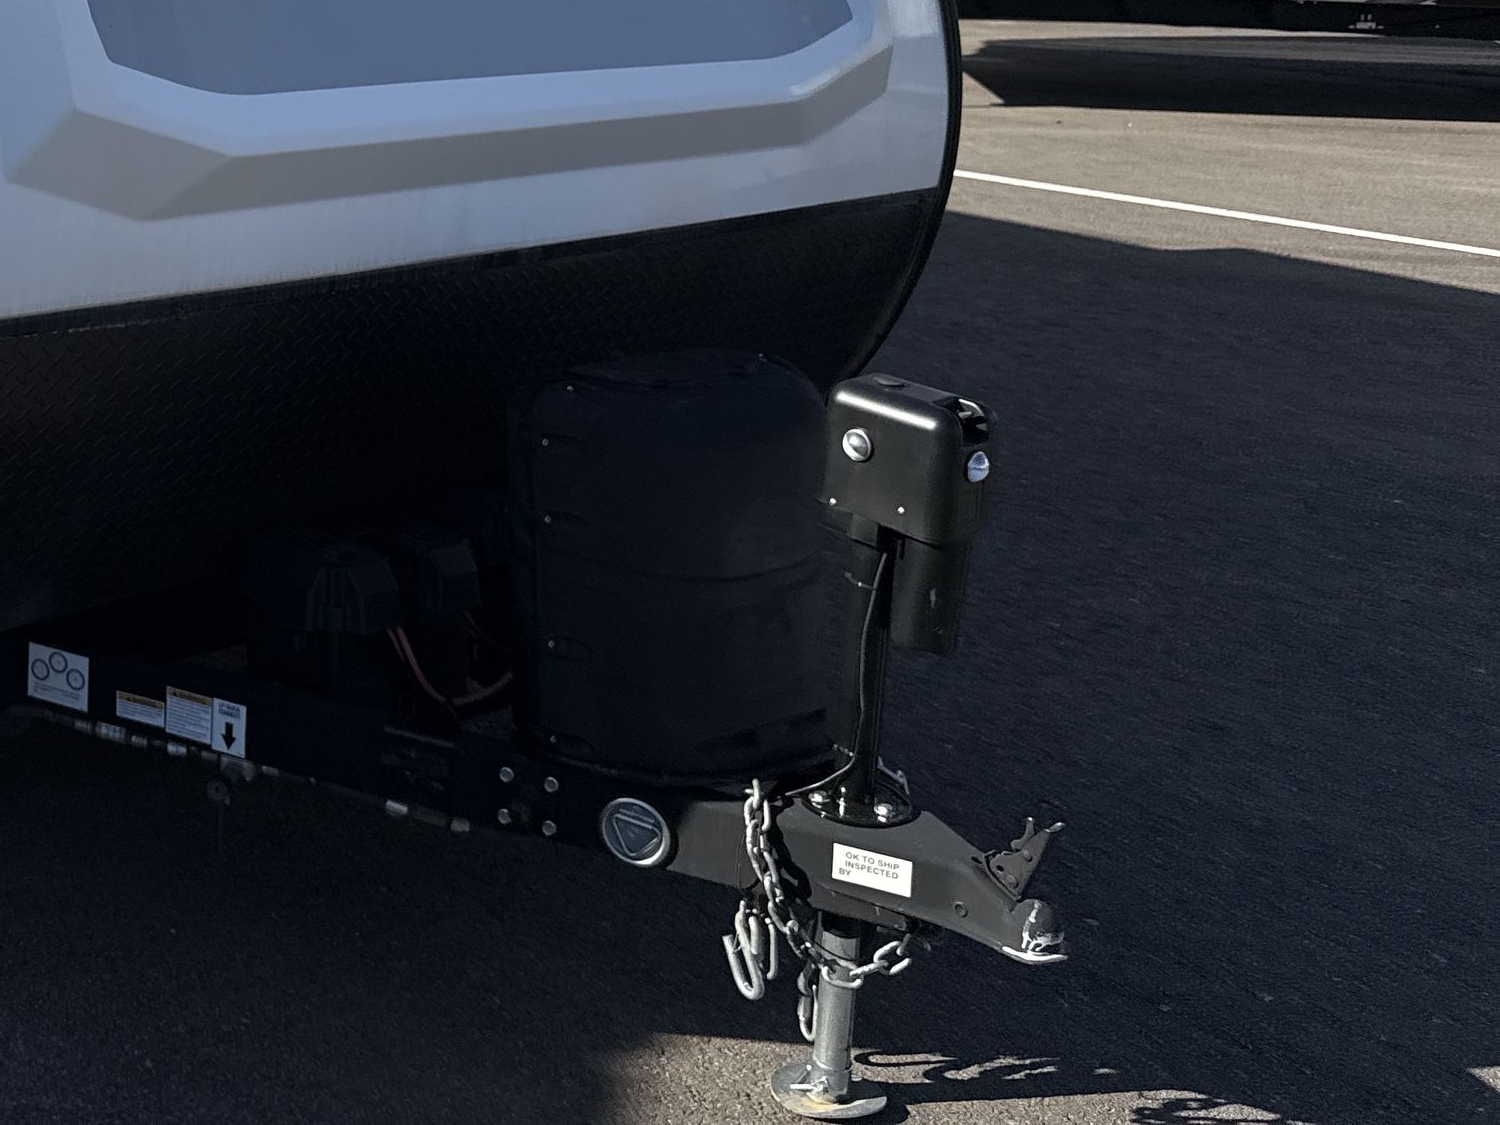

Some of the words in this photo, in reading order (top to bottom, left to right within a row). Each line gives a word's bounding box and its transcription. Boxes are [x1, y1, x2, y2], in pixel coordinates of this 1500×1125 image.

[844, 860, 899, 879] INSPECTED
[845, 851, 860, 861] OK
[862, 855, 875, 865] TO
[877, 859, 900, 870] SHIP
[838, 867, 852, 876] BY
